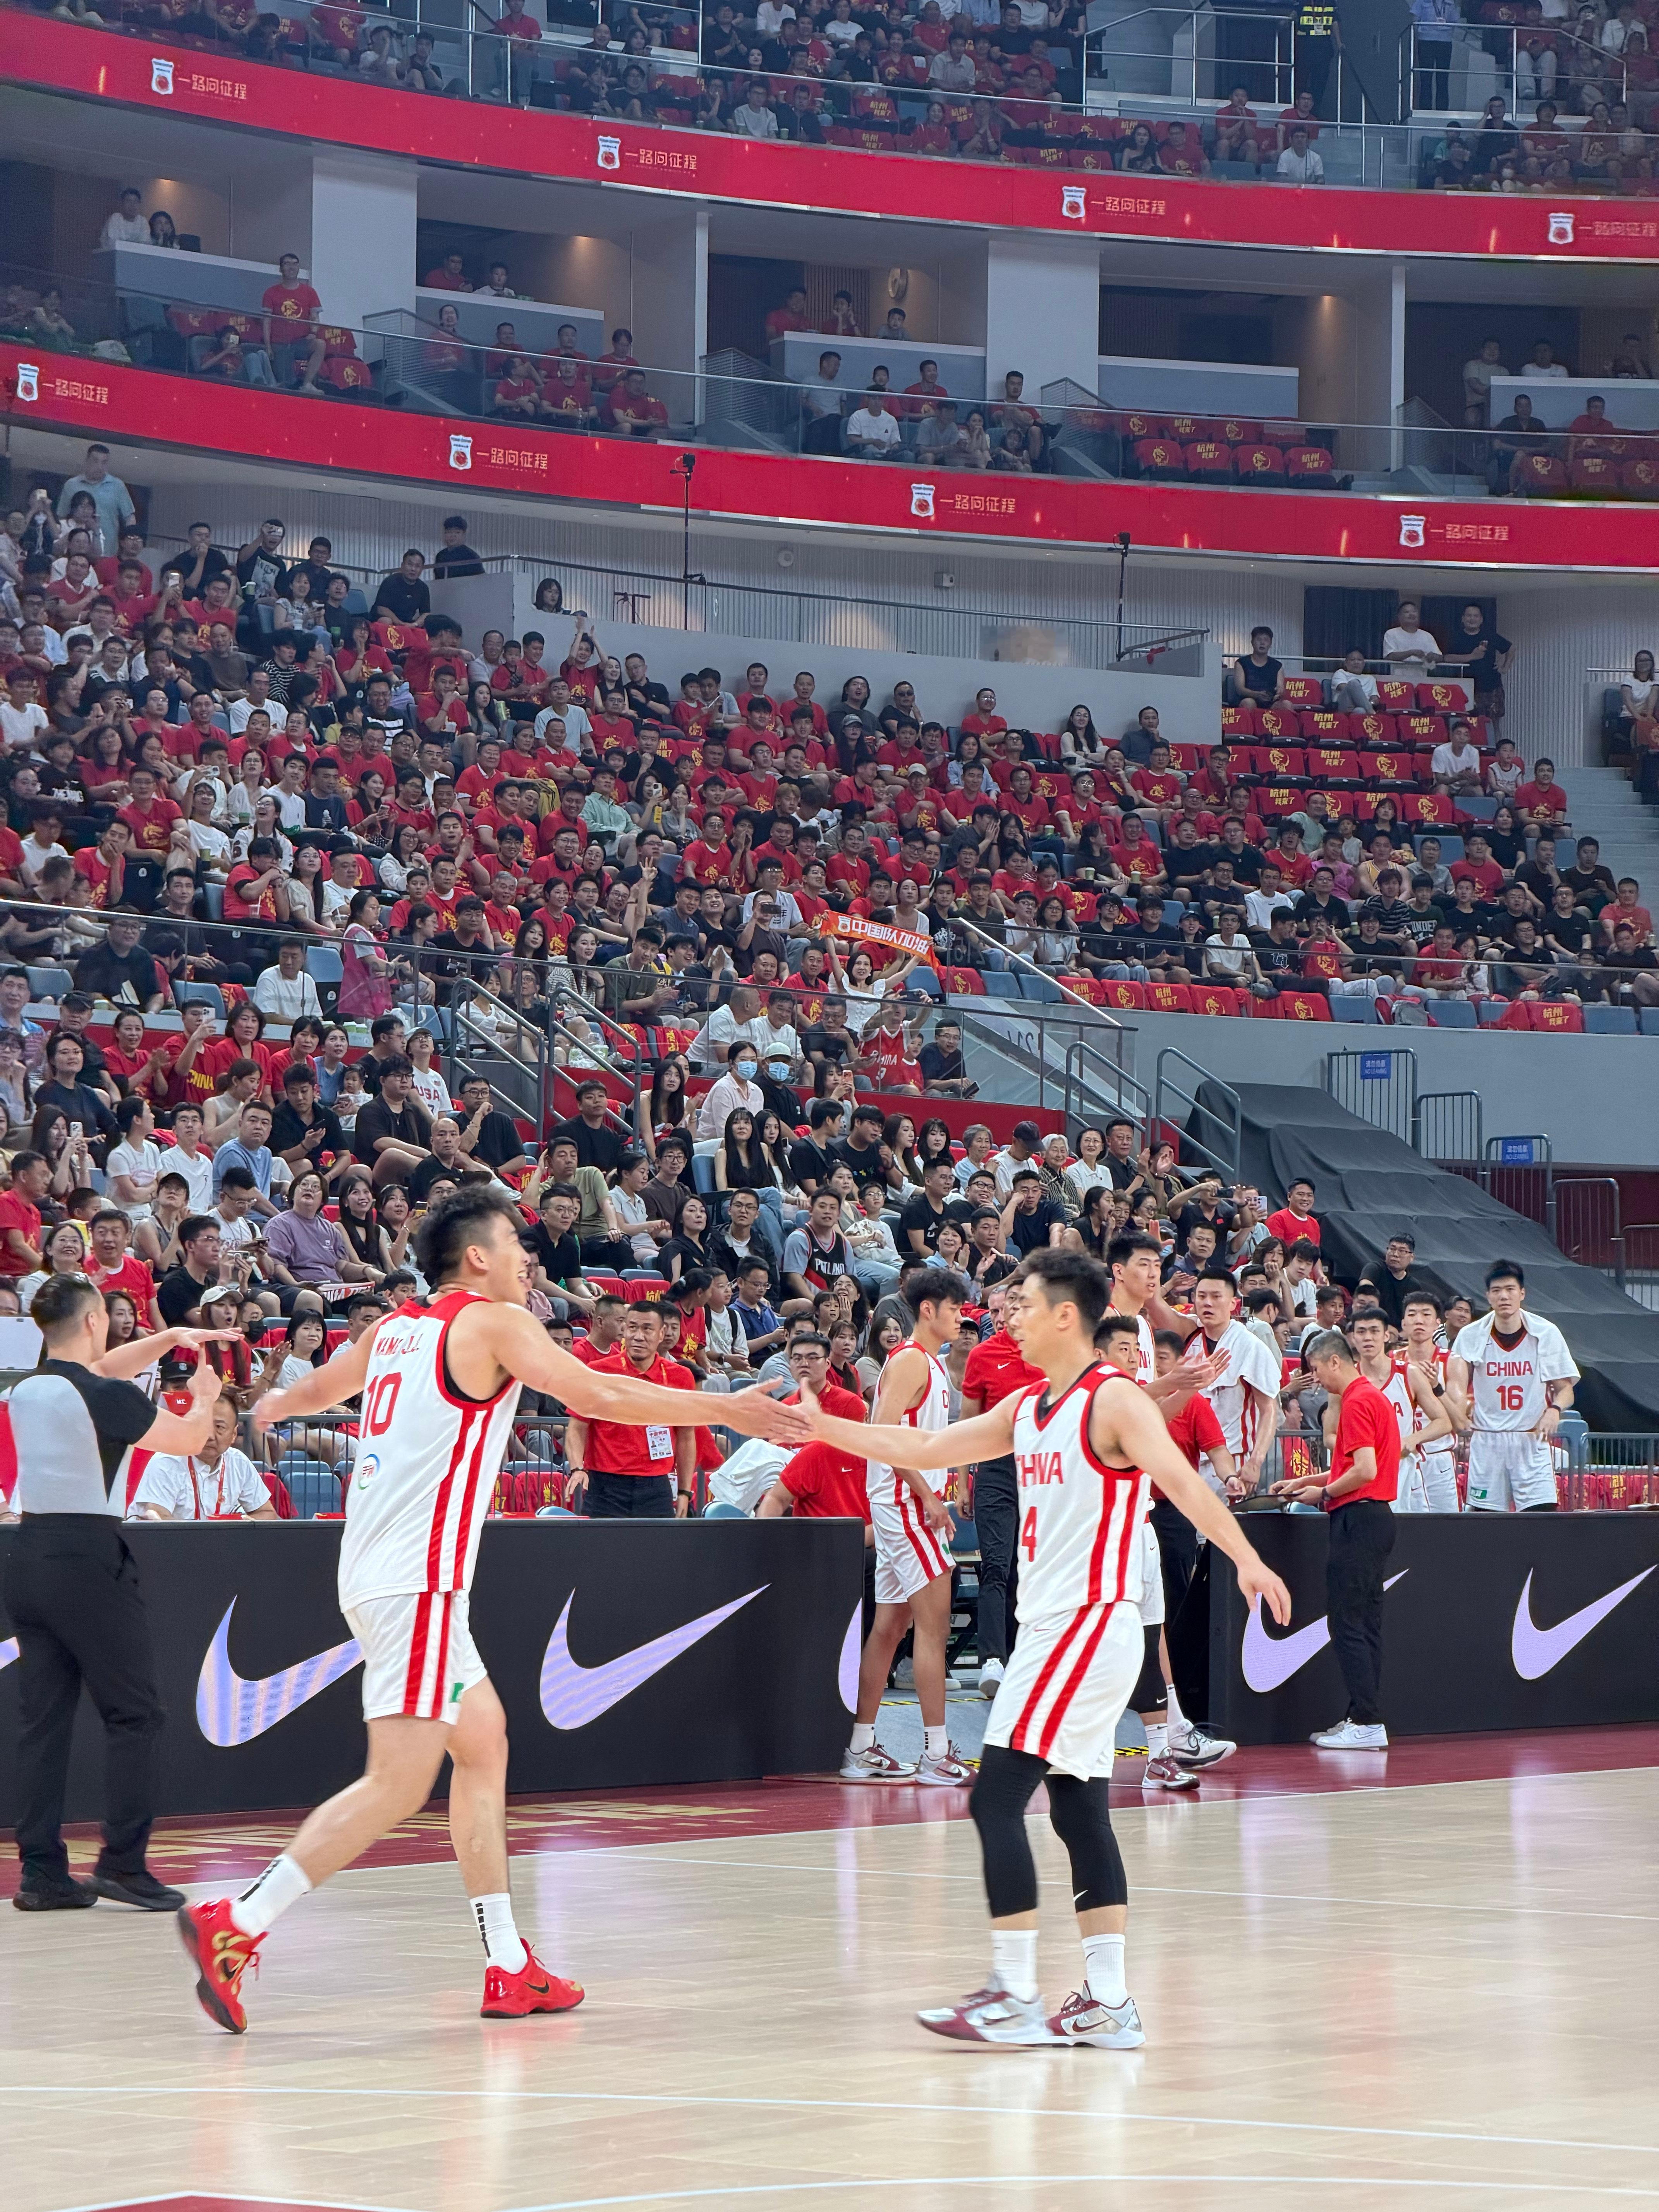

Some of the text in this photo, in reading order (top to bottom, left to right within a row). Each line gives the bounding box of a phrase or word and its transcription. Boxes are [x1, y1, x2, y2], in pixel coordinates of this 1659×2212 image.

[1197, 443, 1215, 452] 杭州
[1302, 453, 1319, 462] 杭州
[1286, 681, 1305, 690] 杭州
[1384, 682, 1401, 693] 杭州
[1314, 713, 1333, 721] 杭州
[1410, 717, 1429, 726] 杭州
[1270, 789, 1289, 797] 杭州
[852, 919, 929, 955] 中国队加油
[1073, 983, 1089, 993] 杭州
[1156, 987, 1171, 998] 杭州
[1543, 1006, 1563, 1018] 杭州
[186, 1069, 215, 1091] CHINA
[416, 1085, 440, 1102] USA
[1487, 1361, 1534, 1377] CHINA
[1496, 1385, 1523, 1410] 16
[362, 1372, 403, 1439] 10
[1022, 1506, 1037, 1562] 4
